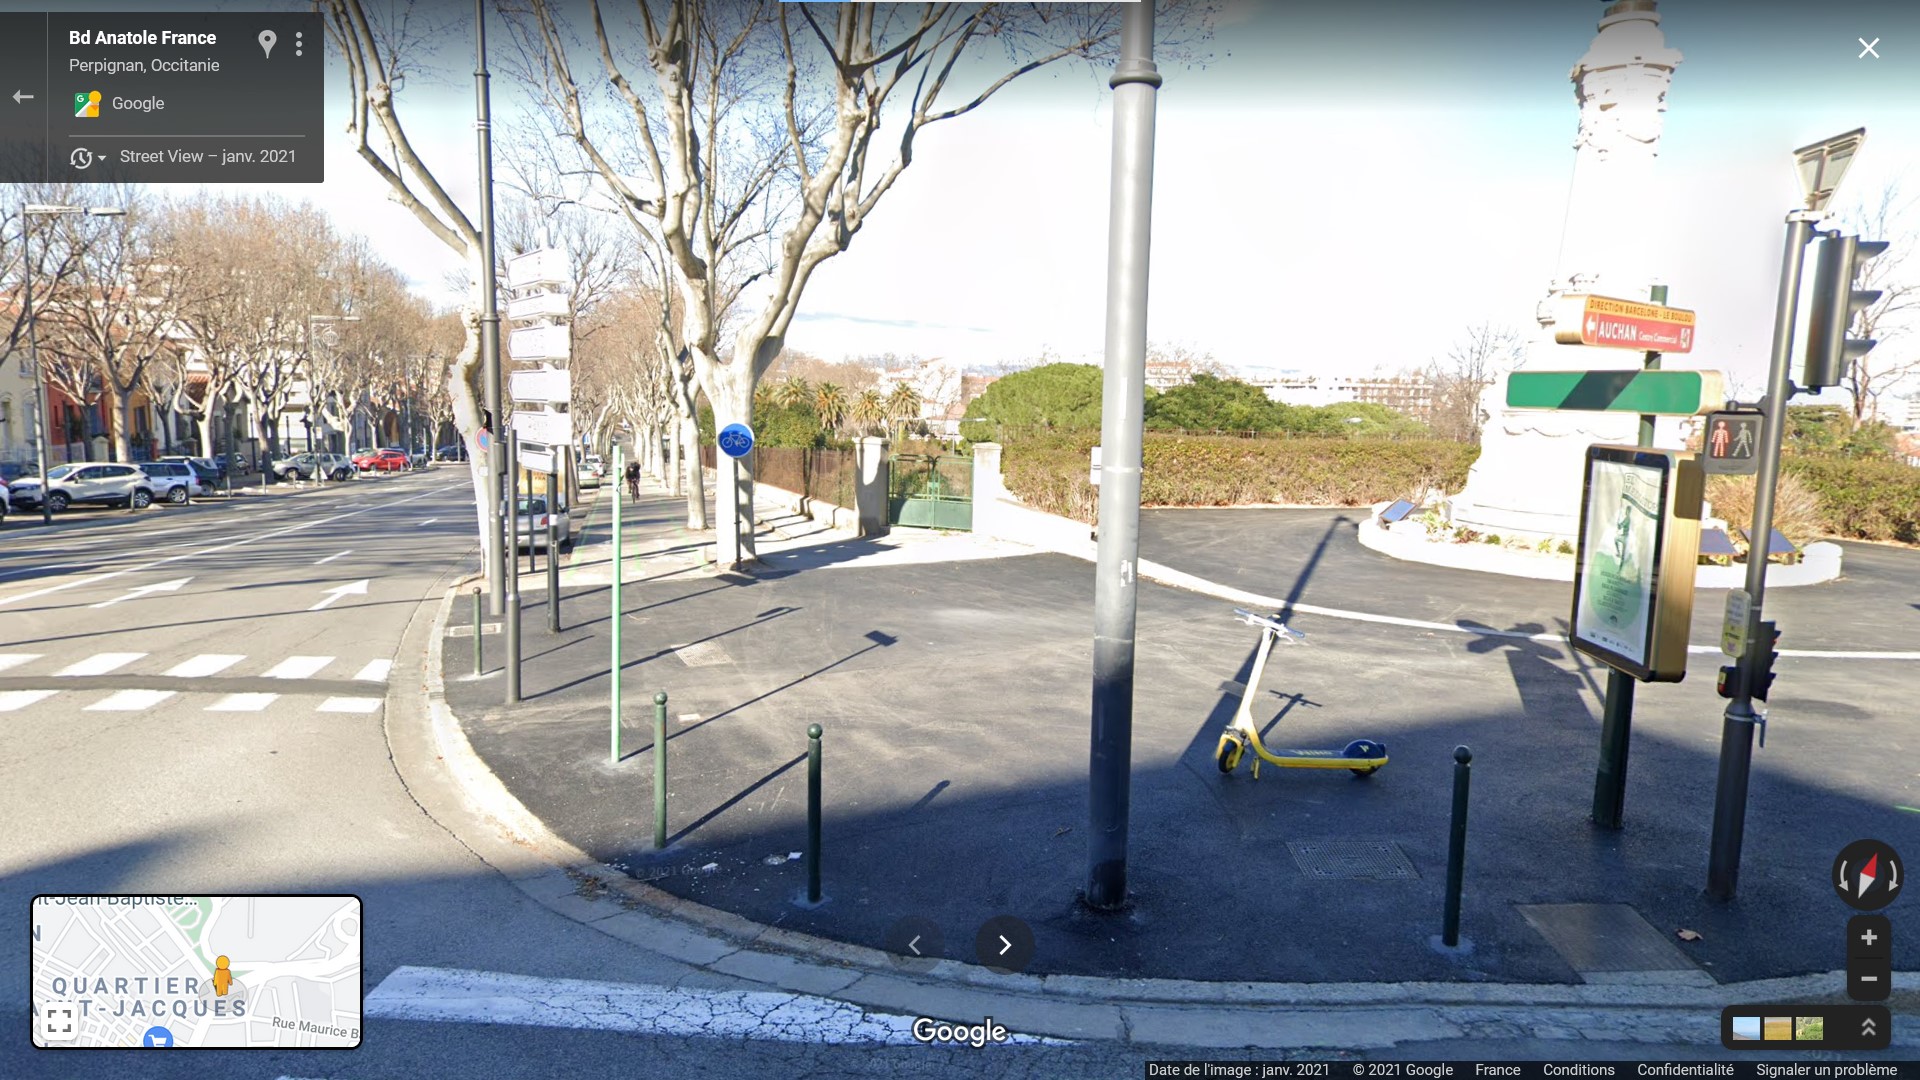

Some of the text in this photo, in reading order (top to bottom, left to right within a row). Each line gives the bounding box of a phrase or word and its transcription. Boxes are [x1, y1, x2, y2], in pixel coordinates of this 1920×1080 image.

[1589, 299, 1624, 313] DIRECTION
[1625, 305, 1659, 319] BARCELONE
[1662, 311, 1671, 320] LE
[1598, 321, 1637, 341] AUCHAN
